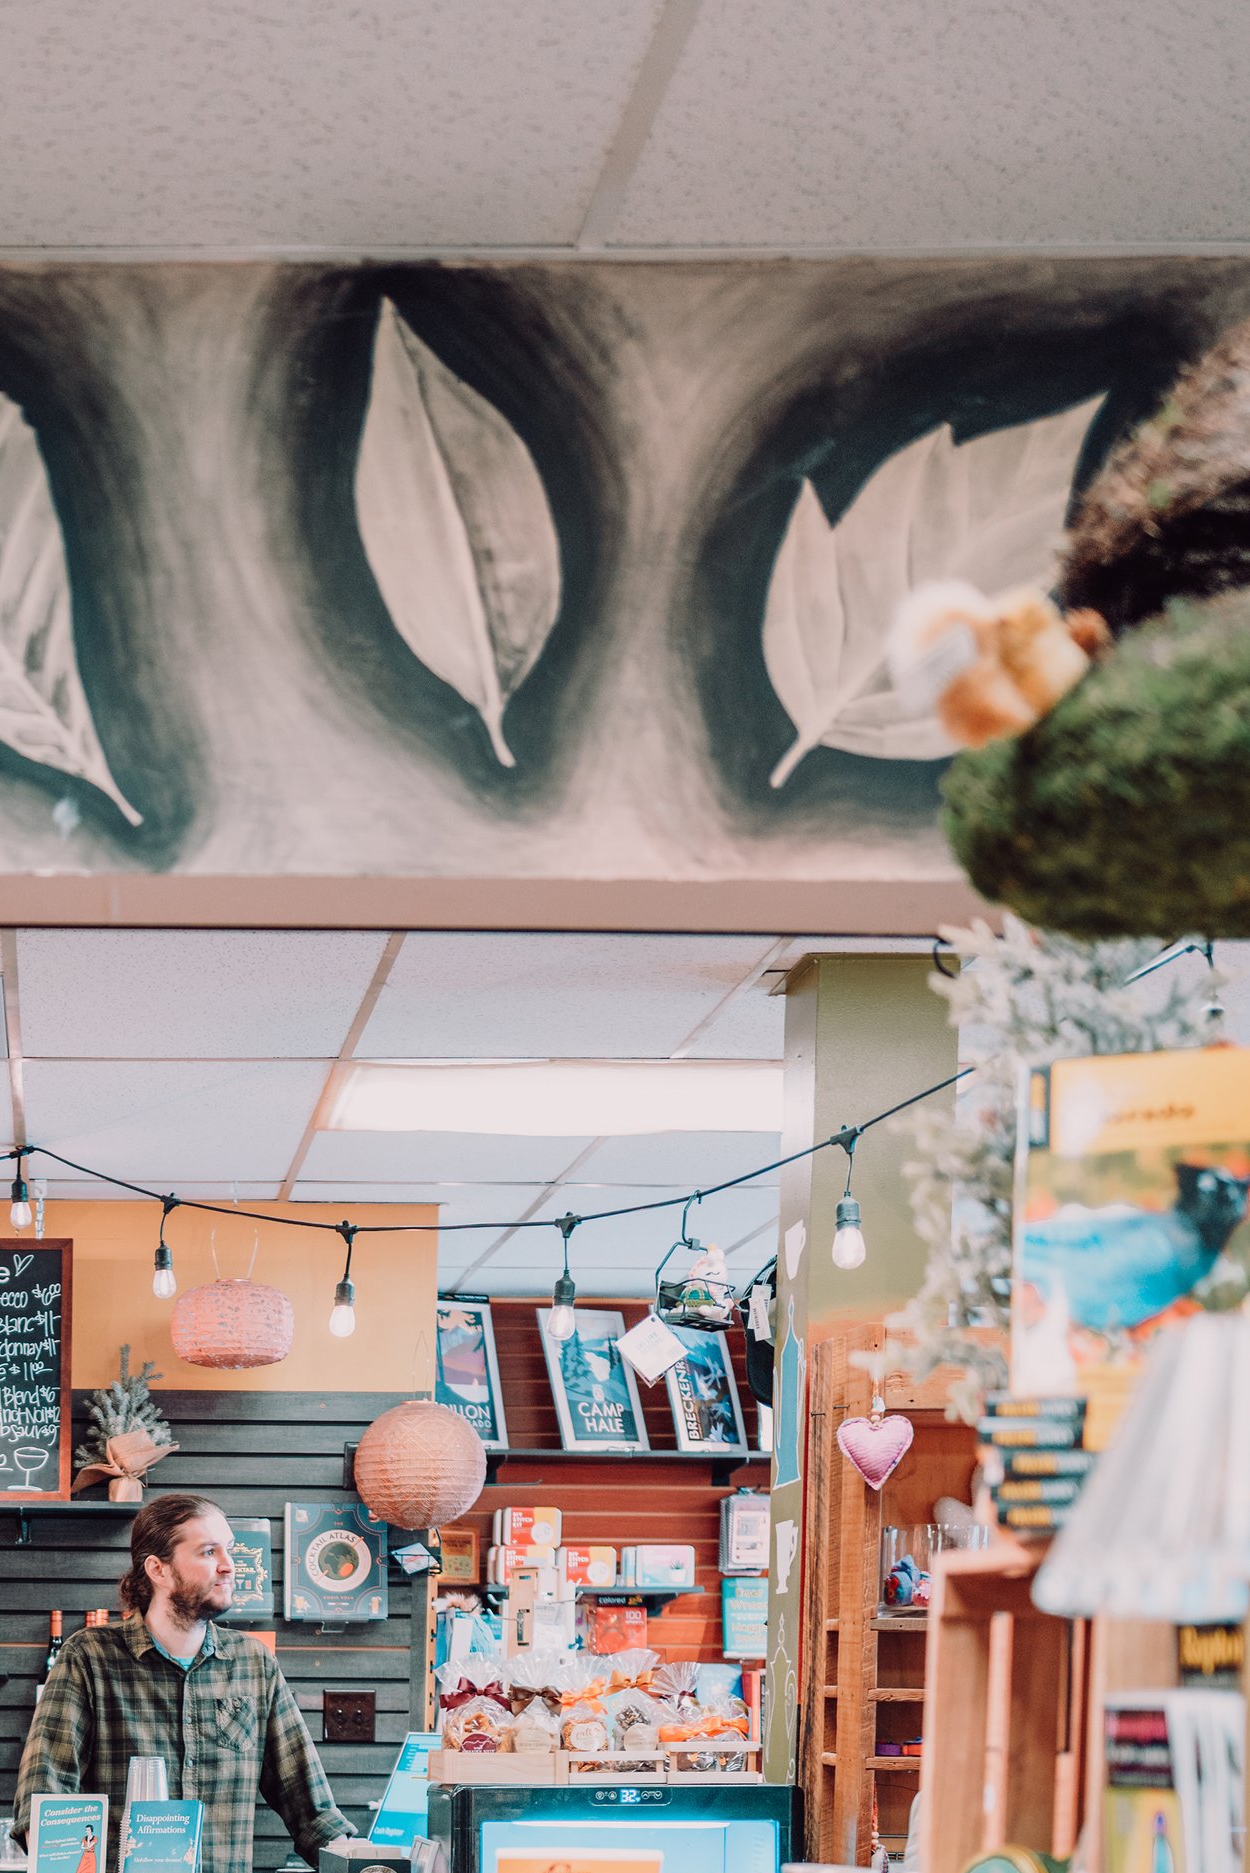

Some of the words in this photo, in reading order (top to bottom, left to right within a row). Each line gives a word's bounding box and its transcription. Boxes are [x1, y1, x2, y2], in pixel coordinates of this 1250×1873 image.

[674, 1357, 701, 1441] BRECKENR
[578, 1401, 625, 1417] CAMP
[585, 1418, 625, 1434] HALE
[309, 1538, 328, 1577] COCKTAIL
[329, 1532, 357, 1544] ATLAS
[625, 1611, 642, 1619] 100
[620, 1790, 637, 1802] 32
[44, 1807, 83, 1818] Consider
[84, 1805, 99, 1813] the
[40, 1814, 102, 1827] Consequences
[136, 1813, 190, 1825] Disappointing
[137, 1826, 186, 1834] Affirmations
